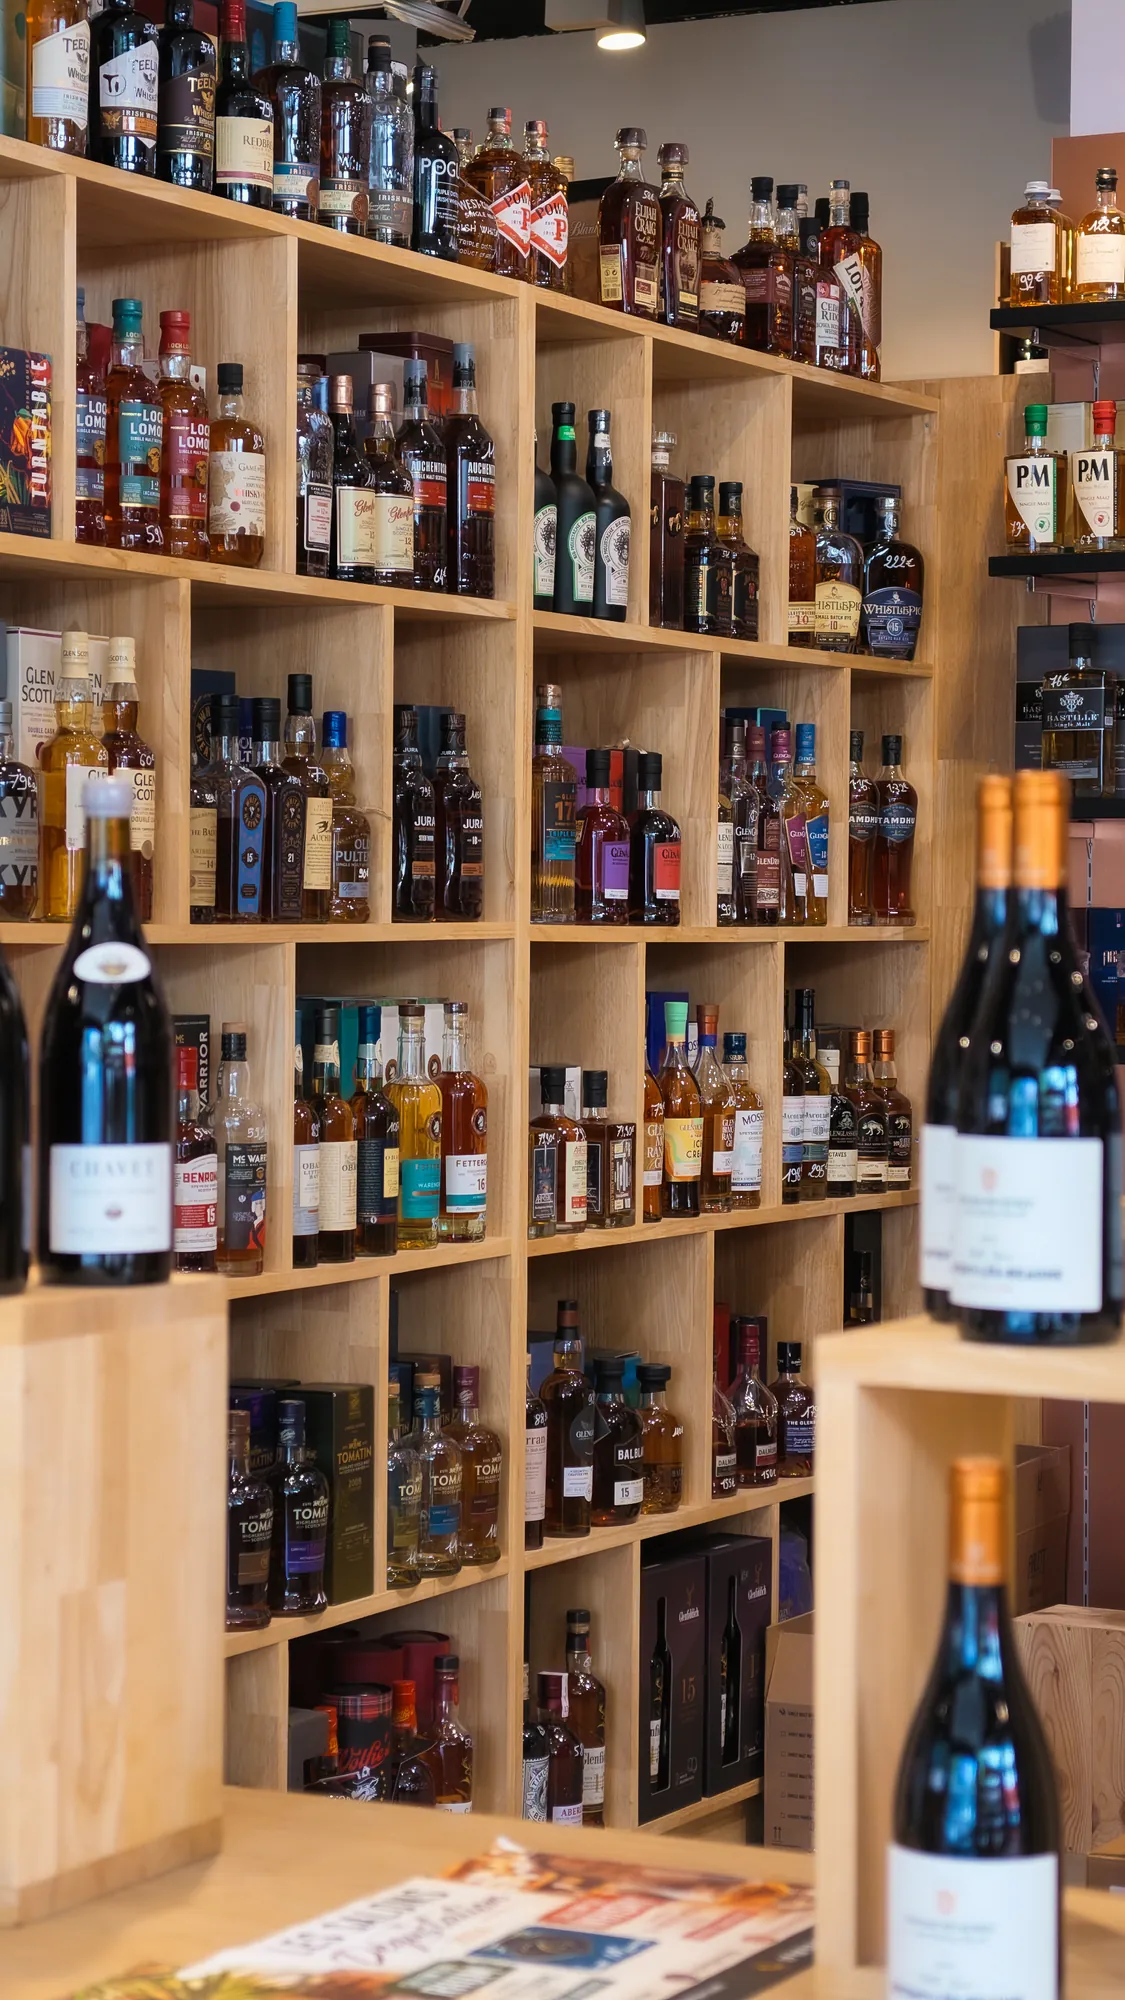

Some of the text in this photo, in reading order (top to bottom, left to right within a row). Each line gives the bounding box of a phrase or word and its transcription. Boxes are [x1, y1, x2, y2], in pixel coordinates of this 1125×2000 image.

[635, 201, 657, 220] ELIJAH
[635, 215, 656, 237] CRAIG
[678, 219, 698, 238] ELIJAH
[677, 235, 698, 252] CRAIG
[31, 360, 47, 498] TURNTABLE
[830, 621, 838, 630] 10
[26, 667, 55, 685] GLEN
[1047, 713, 1099, 722] BASTILLE
[28, 726, 44, 734] DOUBLE
[414, 816, 436, 826] JURA
[462, 819, 483, 829] JURA
[246, 853, 253, 863] 15
[287, 853, 295, 863] 21
[477, 1178, 485, 1191] 16
[206, 1207, 215, 1223] 15
[337, 1446, 372, 1465] TOMATIN
[621, 1487, 630, 1498] 15
[681, 1676, 695, 1703] 15
